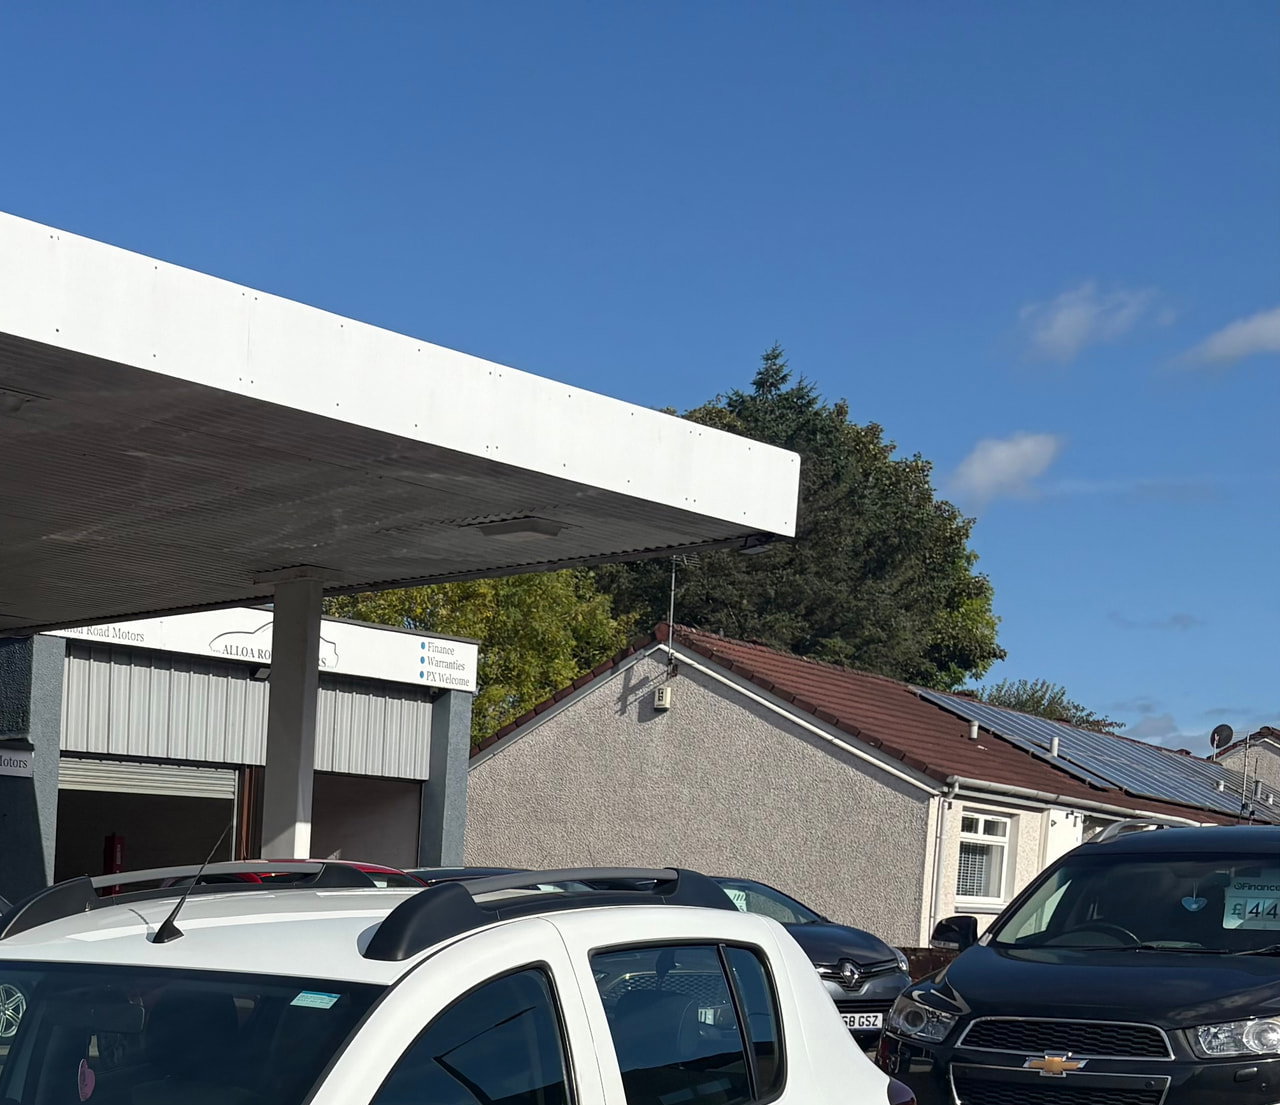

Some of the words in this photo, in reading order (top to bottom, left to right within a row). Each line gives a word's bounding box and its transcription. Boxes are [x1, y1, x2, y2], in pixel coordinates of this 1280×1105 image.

[112, 627, 145, 642] Motors
[222, 644, 255, 660] ALLOA
[427, 641, 455, 656] Finance
[427, 656, 465, 671] Warranties
[426, 671, 437, 682] PX
[438, 673, 470, 687] Welcome
[858, 1015, 878, 1027] GSZ
